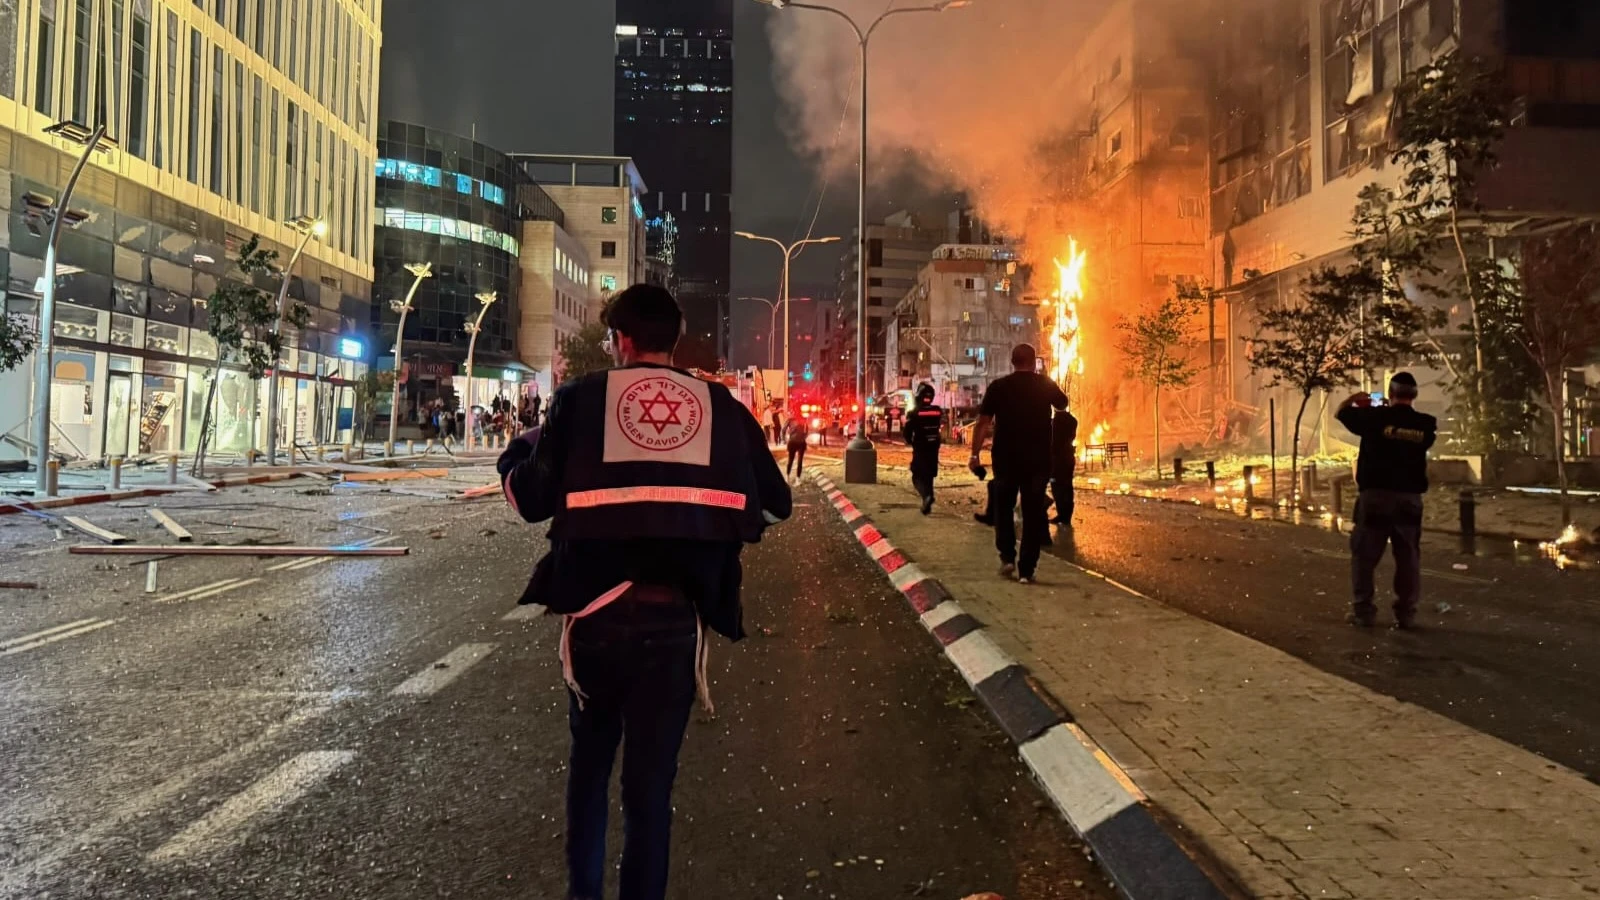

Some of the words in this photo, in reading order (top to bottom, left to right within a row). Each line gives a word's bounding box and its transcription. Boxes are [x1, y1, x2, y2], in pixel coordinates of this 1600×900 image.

[628, 382, 652, 402] אדום
[656, 381, 676, 391] דוד
[677, 391, 695, 405] מגן
[622, 406, 645, 441] MAGEN
[646, 436, 679, 447] DAVID
[681, 410, 697, 439] ADOM
